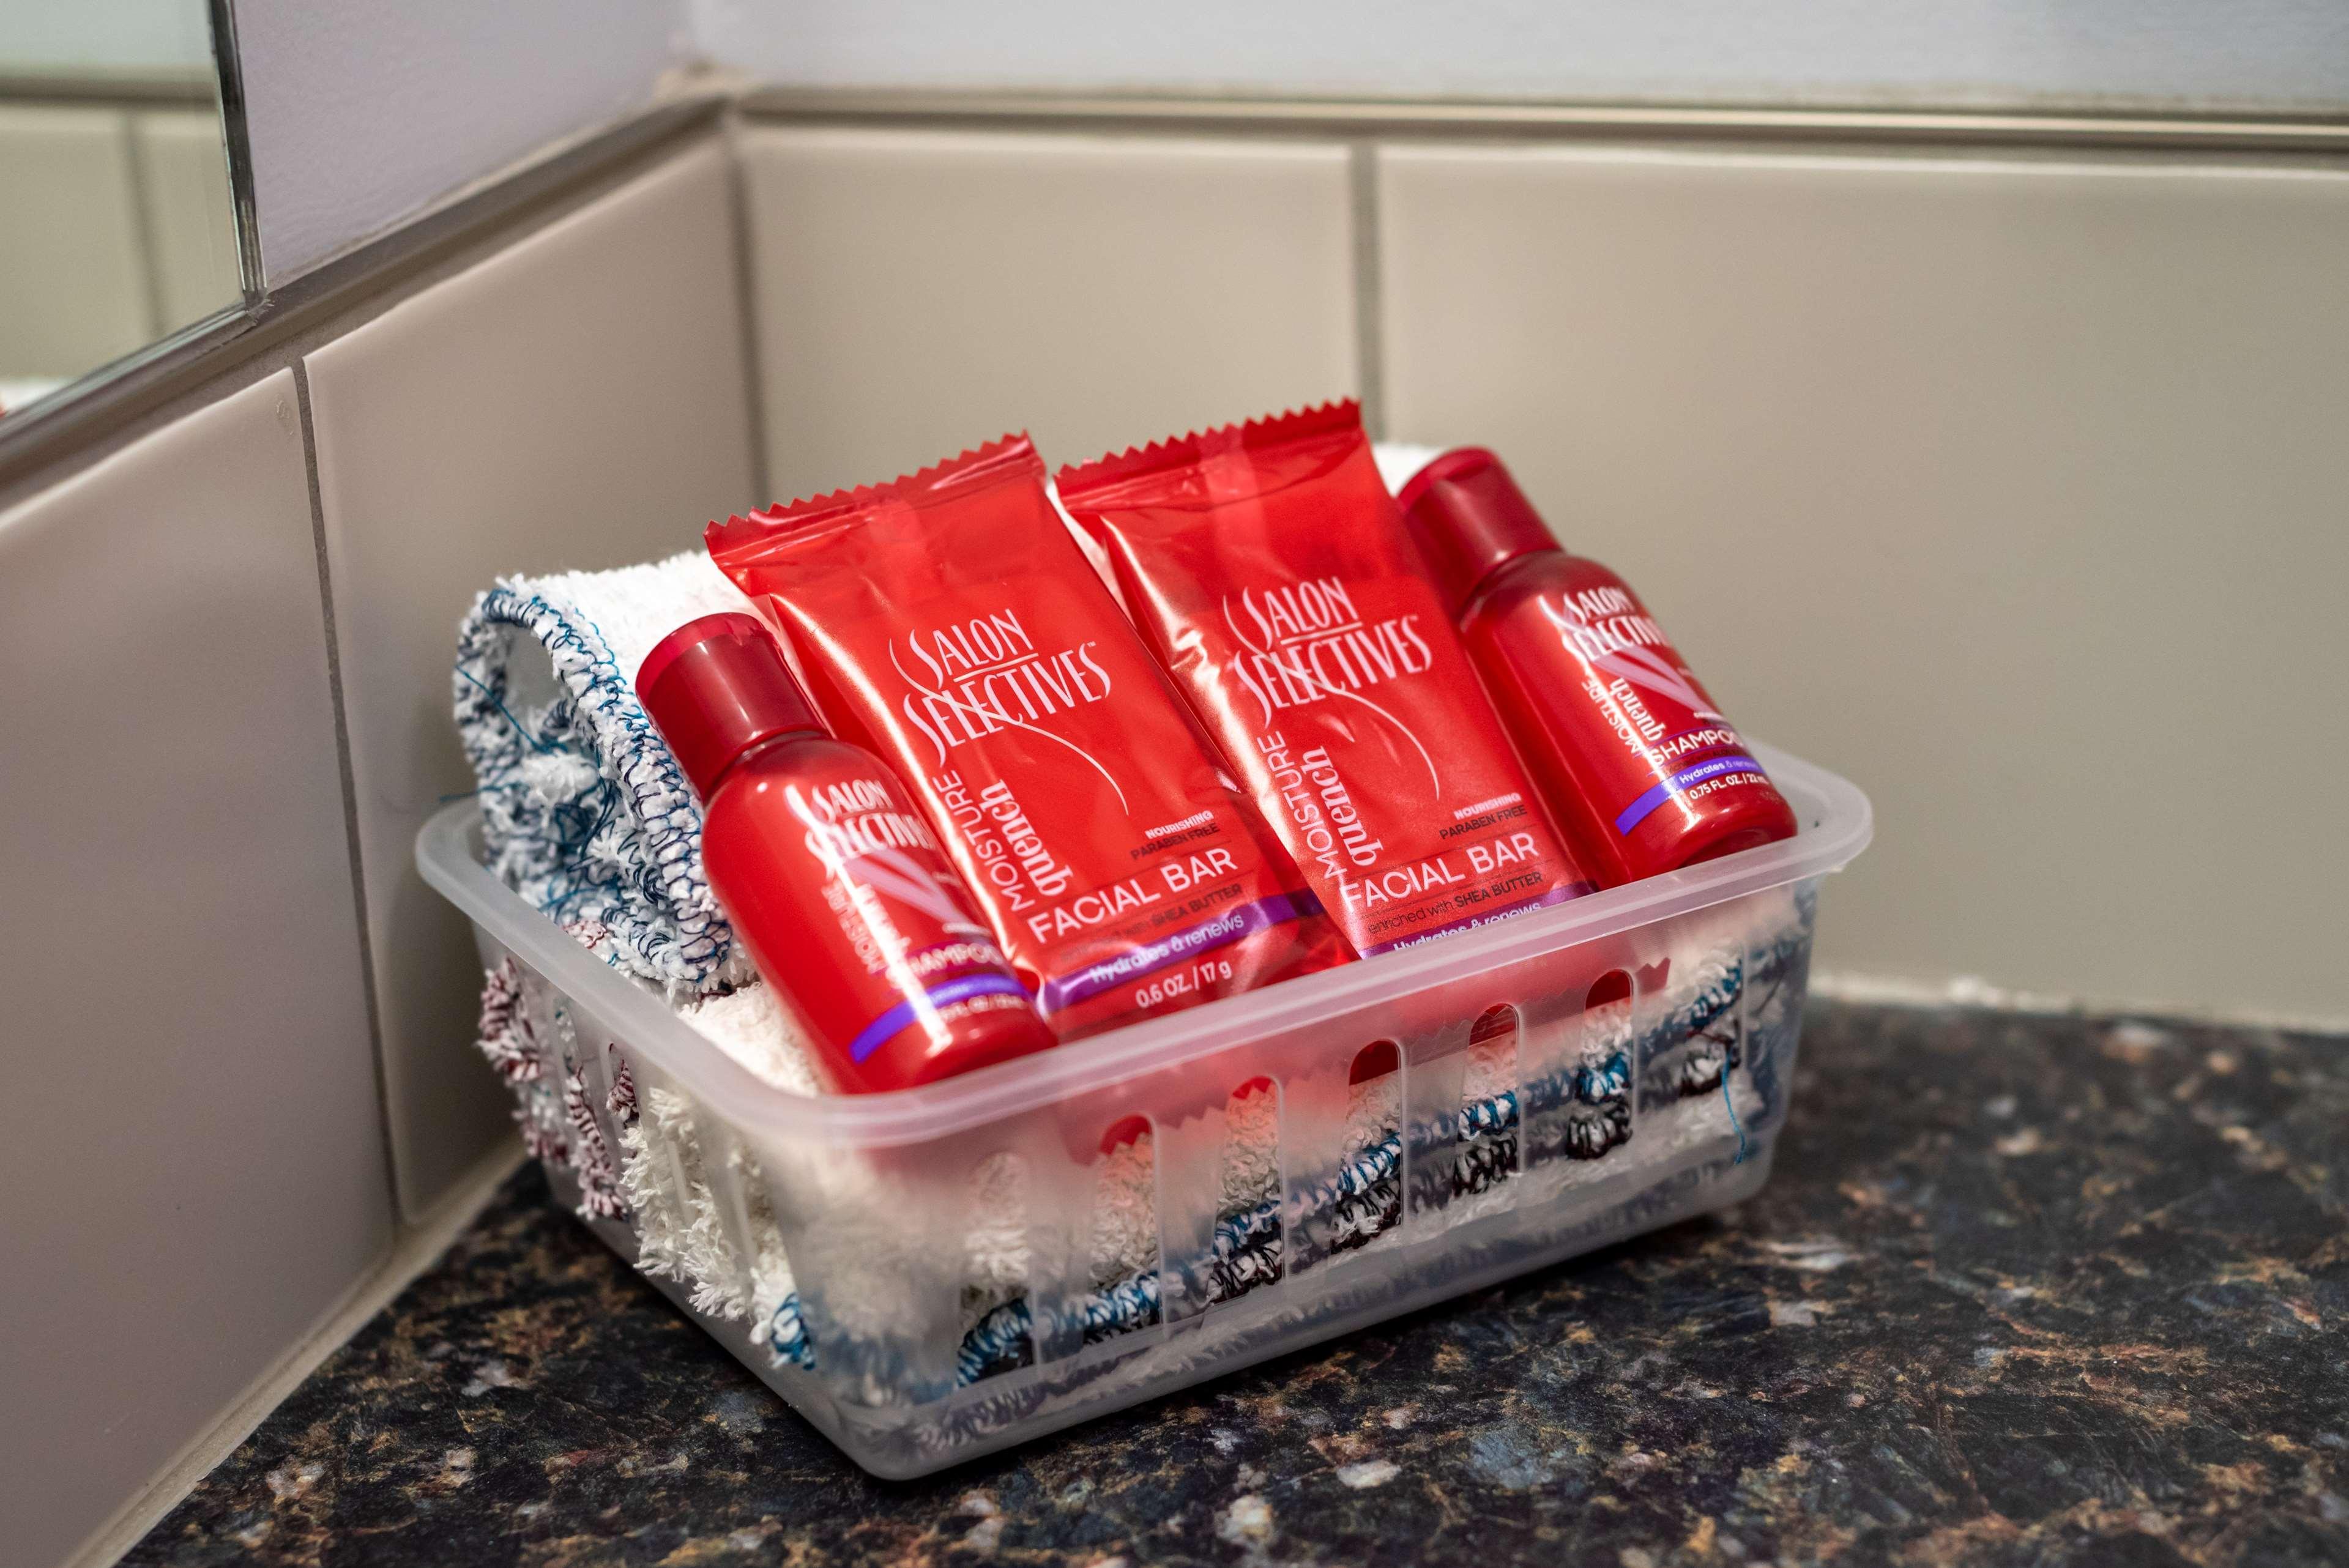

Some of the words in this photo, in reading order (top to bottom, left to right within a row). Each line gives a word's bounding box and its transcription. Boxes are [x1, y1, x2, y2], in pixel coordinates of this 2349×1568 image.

[1242, 576, 1359, 650] SALON
[1563, 586, 1636, 628] SALON
[909, 608, 1033, 689] SALON
[1234, 615, 1432, 729] SELECTIVES
[903, 642, 1111, 767] SELECTIVES
[1609, 677, 1666, 741] quench
[1678, 760, 1725, 784] Hydrates
[1689, 783, 1711, 800] 0.75
[980, 779, 1073, 896] quench
[1144, 810, 1215, 839] NOURISHING
[1257, 731, 1348, 881] MOISTURE
[1300, 746, 1384, 866] quench
[1439, 815, 1496, 840] PARABEN
[1497, 804, 1527, 822] FREE
[1453, 793, 1522, 820] NOURISHING
[933, 769, 1035, 912] MOISTURE
[1131, 834, 1188, 860] PARABEN
[1188, 822, 1220, 841] FREE
[1028, 878, 1161, 944] FACIAL
[1161, 848, 1238, 893] BAR
[1188, 883, 1242, 912] BUTTER
[1339, 858, 1465, 913] FACIAL
[1466, 833, 1539, 874] BAR
[1368, 908, 1426, 934] enriched
[1426, 900, 1455, 916] with
[1454, 888, 1491, 908] SHEA
[1491, 871, 1543, 897] BUTTER
[1185, 914, 1245, 948] renews
[1135, 983, 1164, 1008] 0.6
[1199, 961, 1216, 983] 17
